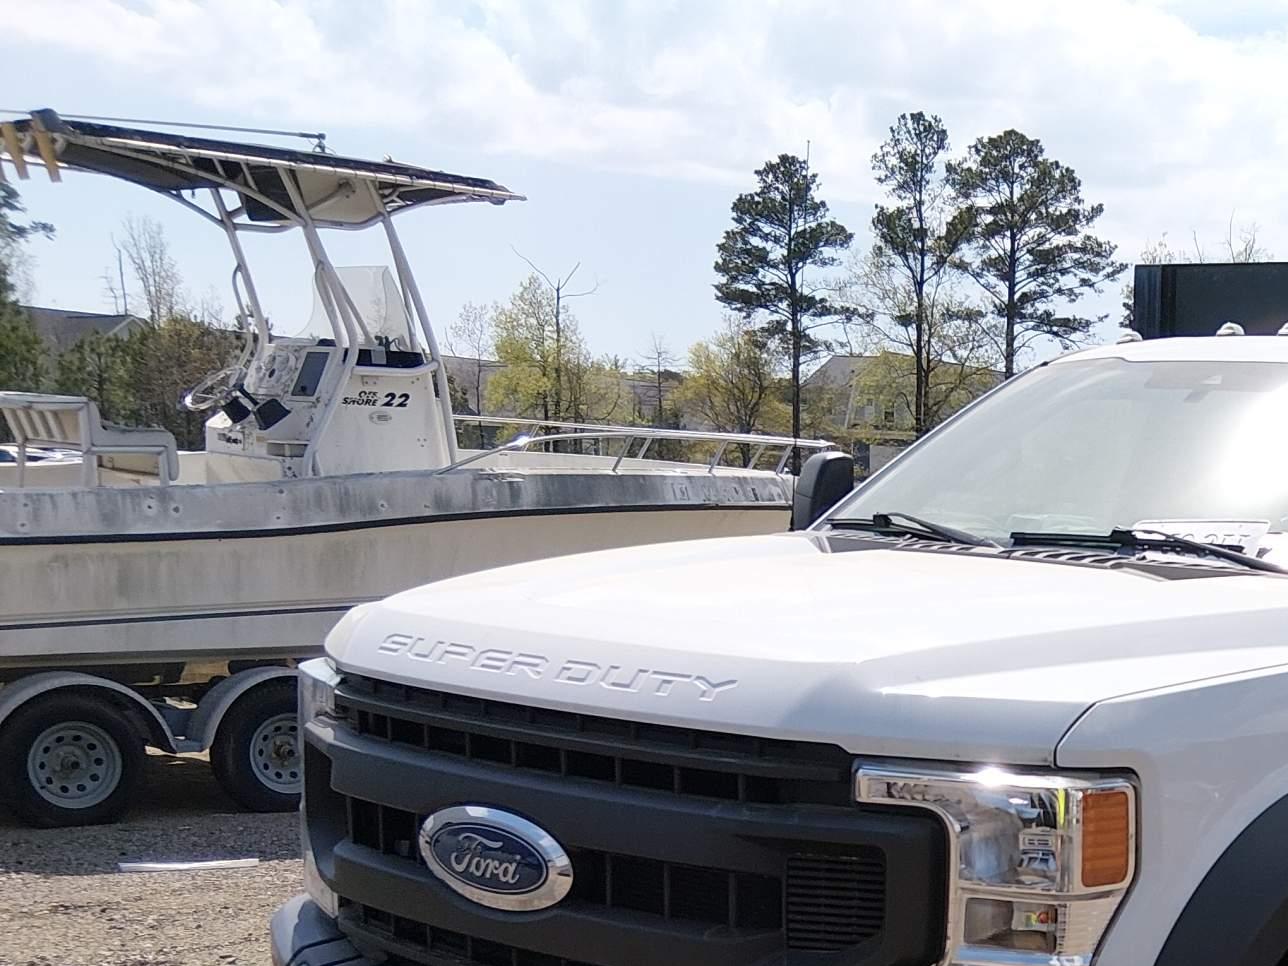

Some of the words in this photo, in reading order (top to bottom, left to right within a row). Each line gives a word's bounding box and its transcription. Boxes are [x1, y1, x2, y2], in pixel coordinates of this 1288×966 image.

[342, 397, 379, 407] SHORE
[381, 392, 410, 408] 22
[378, 633, 550, 680] SUPER
[553, 659, 738, 701] DUTY
[451, 832, 520, 884] Ford
